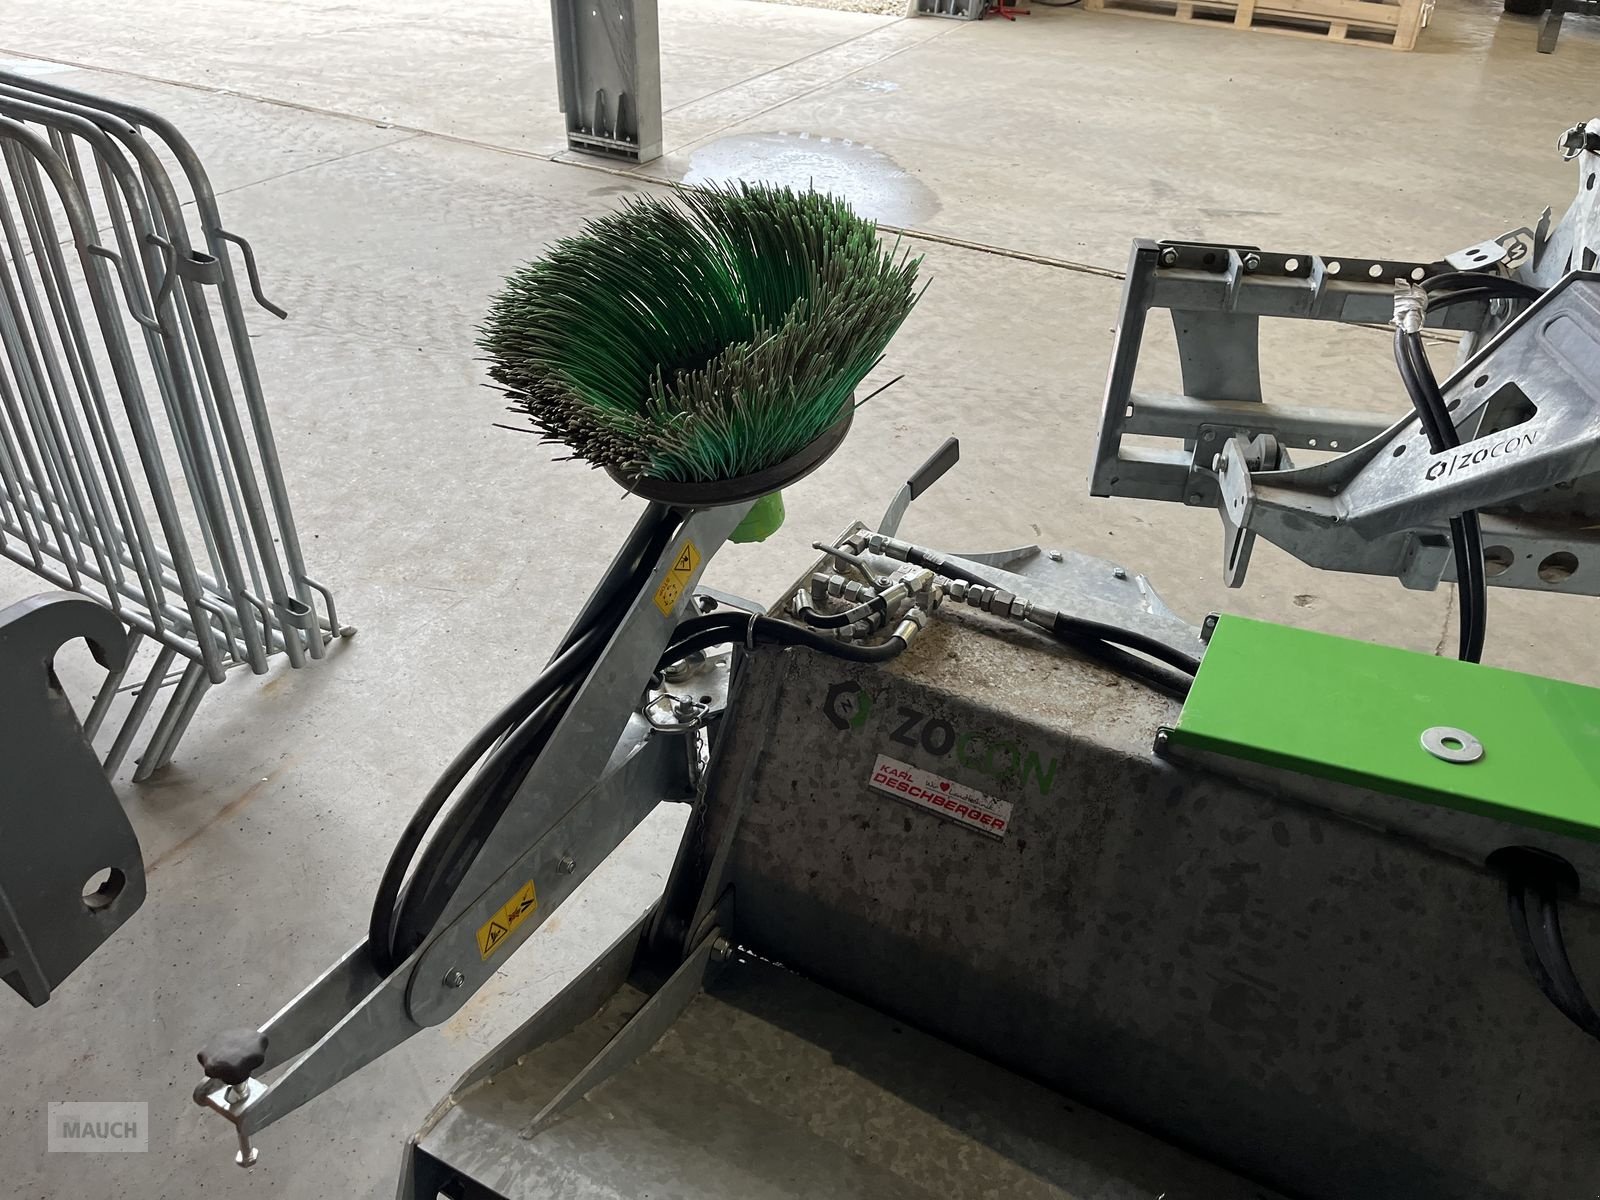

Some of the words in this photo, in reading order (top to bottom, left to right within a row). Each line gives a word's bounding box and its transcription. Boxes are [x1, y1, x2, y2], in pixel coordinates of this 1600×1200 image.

[1457, 431, 1538, 470] ZOCON
[880, 764, 915, 783] KARL
[889, 706, 1057, 796] ZOCON
[873, 773, 1006, 831] DESCHBERGER
